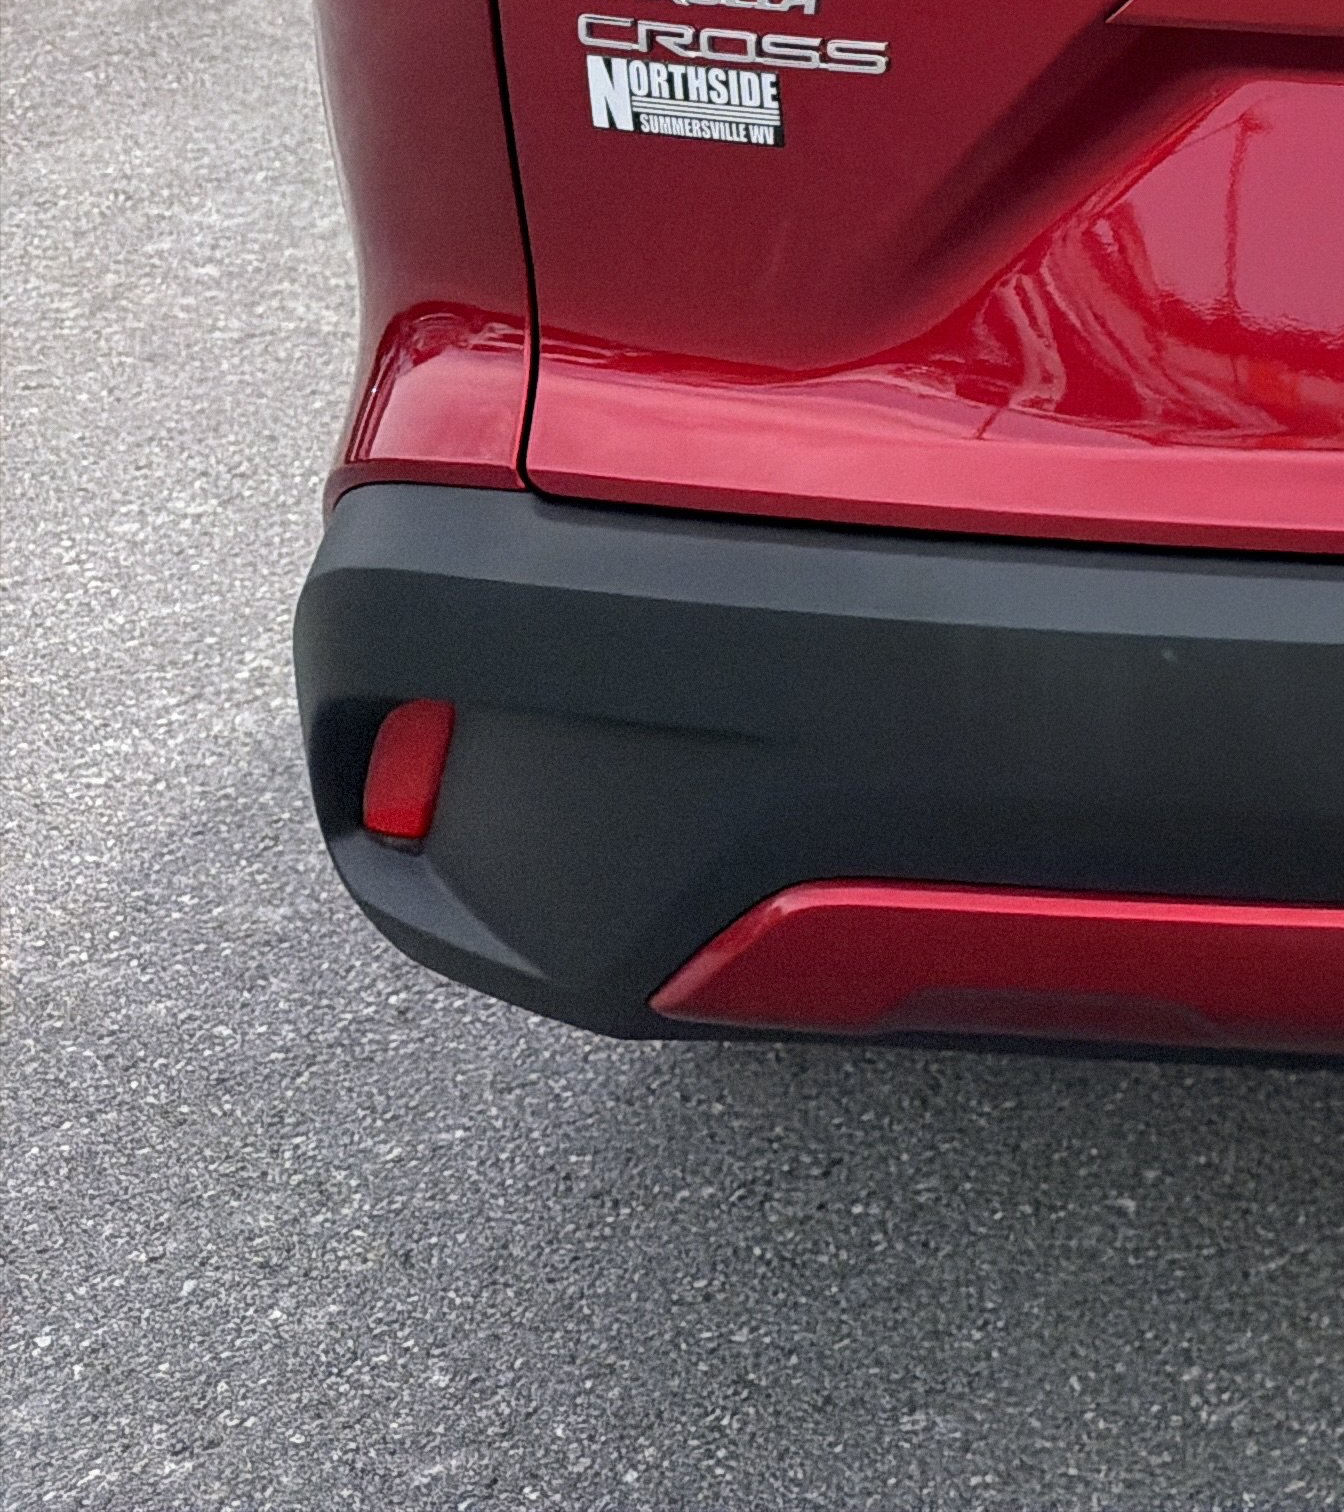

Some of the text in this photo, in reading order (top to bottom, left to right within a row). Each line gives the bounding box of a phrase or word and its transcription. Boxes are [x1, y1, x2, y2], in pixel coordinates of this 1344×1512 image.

[577, 13, 889, 75] CROSS
[587, 54, 780, 131] NORTHSIDE
[640, 112, 775, 146] SUMMERSVILLE WV
